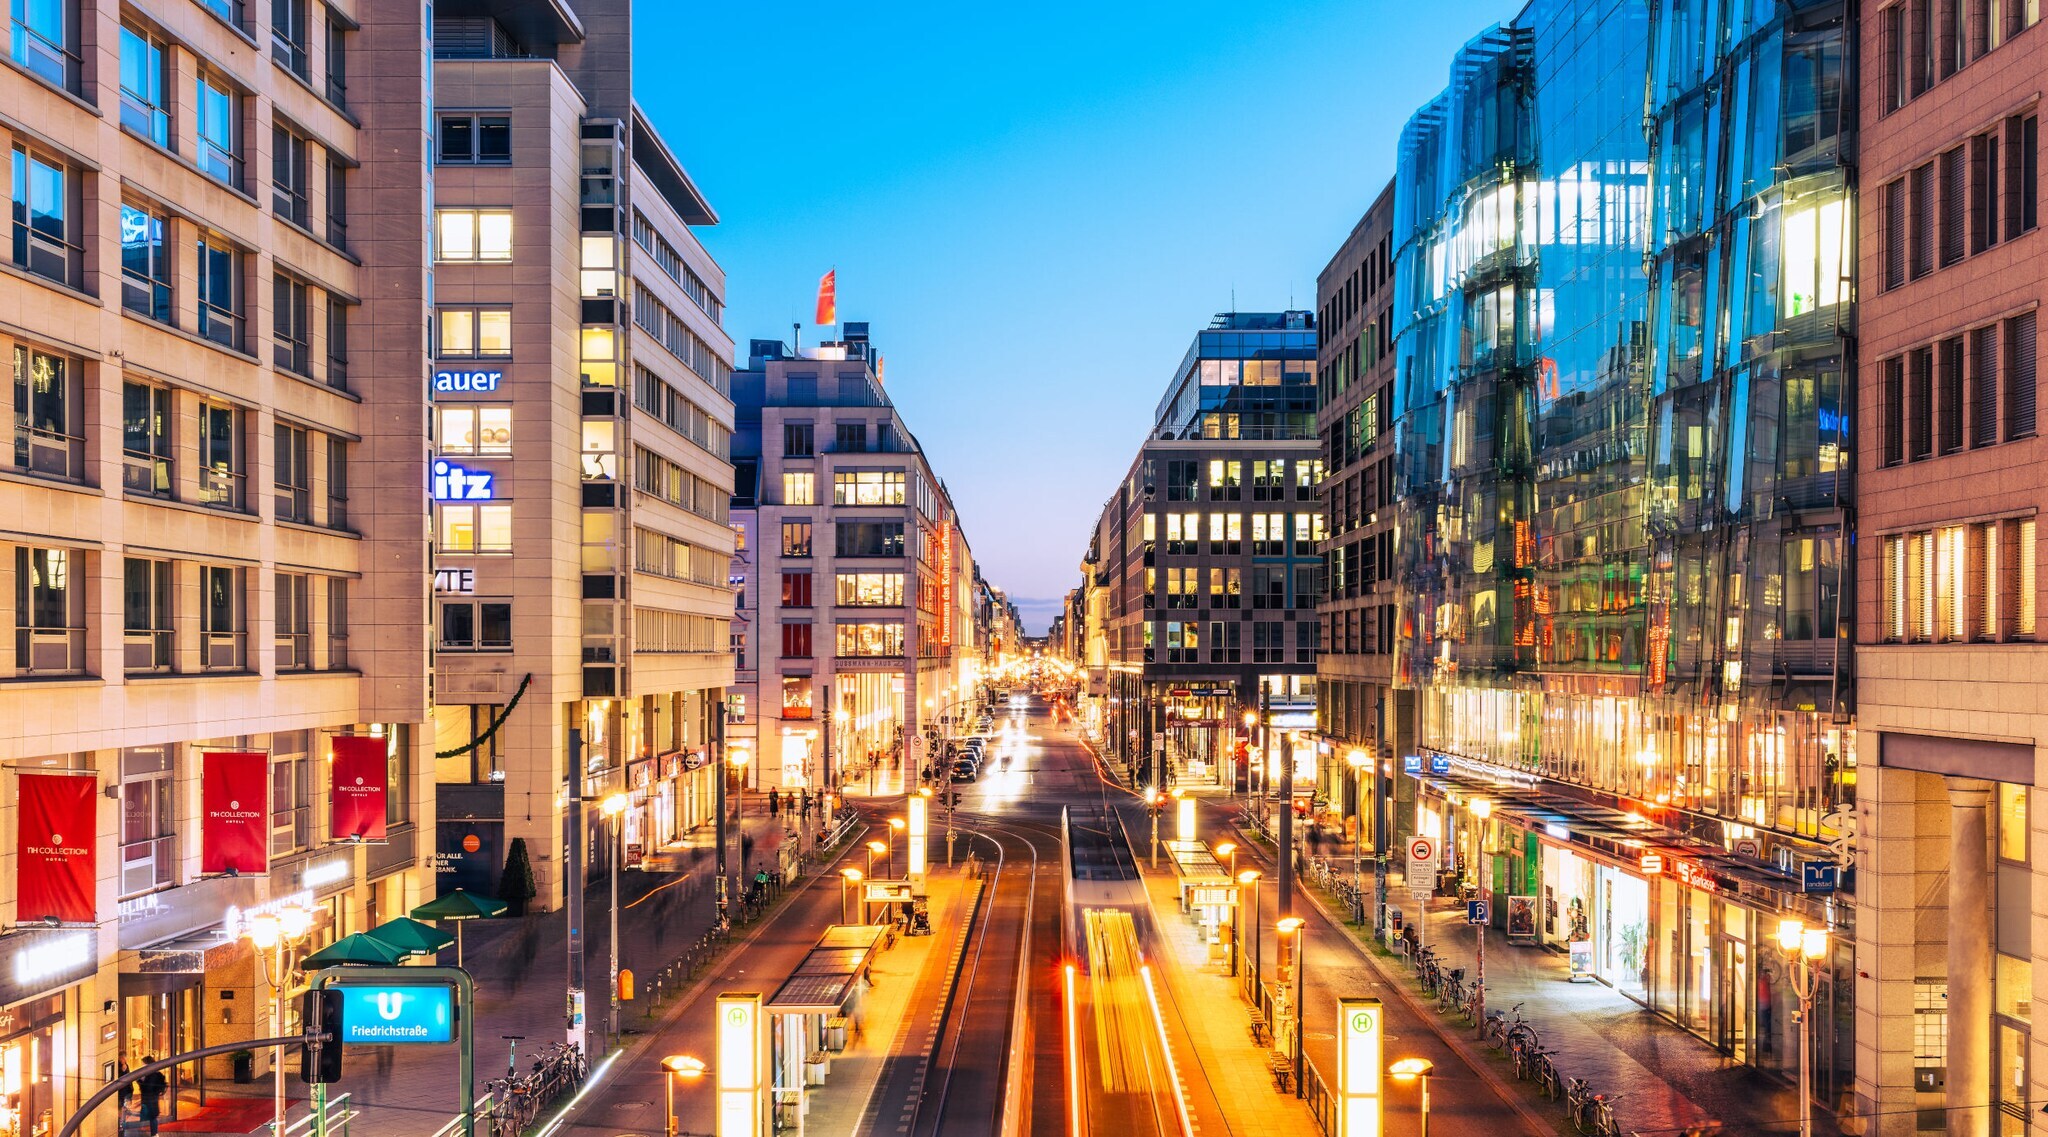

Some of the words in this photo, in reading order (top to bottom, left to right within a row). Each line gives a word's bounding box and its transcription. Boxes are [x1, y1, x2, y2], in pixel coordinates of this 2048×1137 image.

[433, 372, 501, 391] auer
[942, 523, 950, 585] KulturKaufhaus
[942, 587, 950, 600] das
[942, 602, 950, 643] Dussmann
[39, 847, 88, 855] COLLECTION
[1690, 867, 1716, 892] Sparkasse
[1476, 906, 1484, 919] P
[377, 992, 402, 1020] U
[352, 1025, 428, 1036] Friedrichstraße
[1357, 1017, 1367, 1028] H
